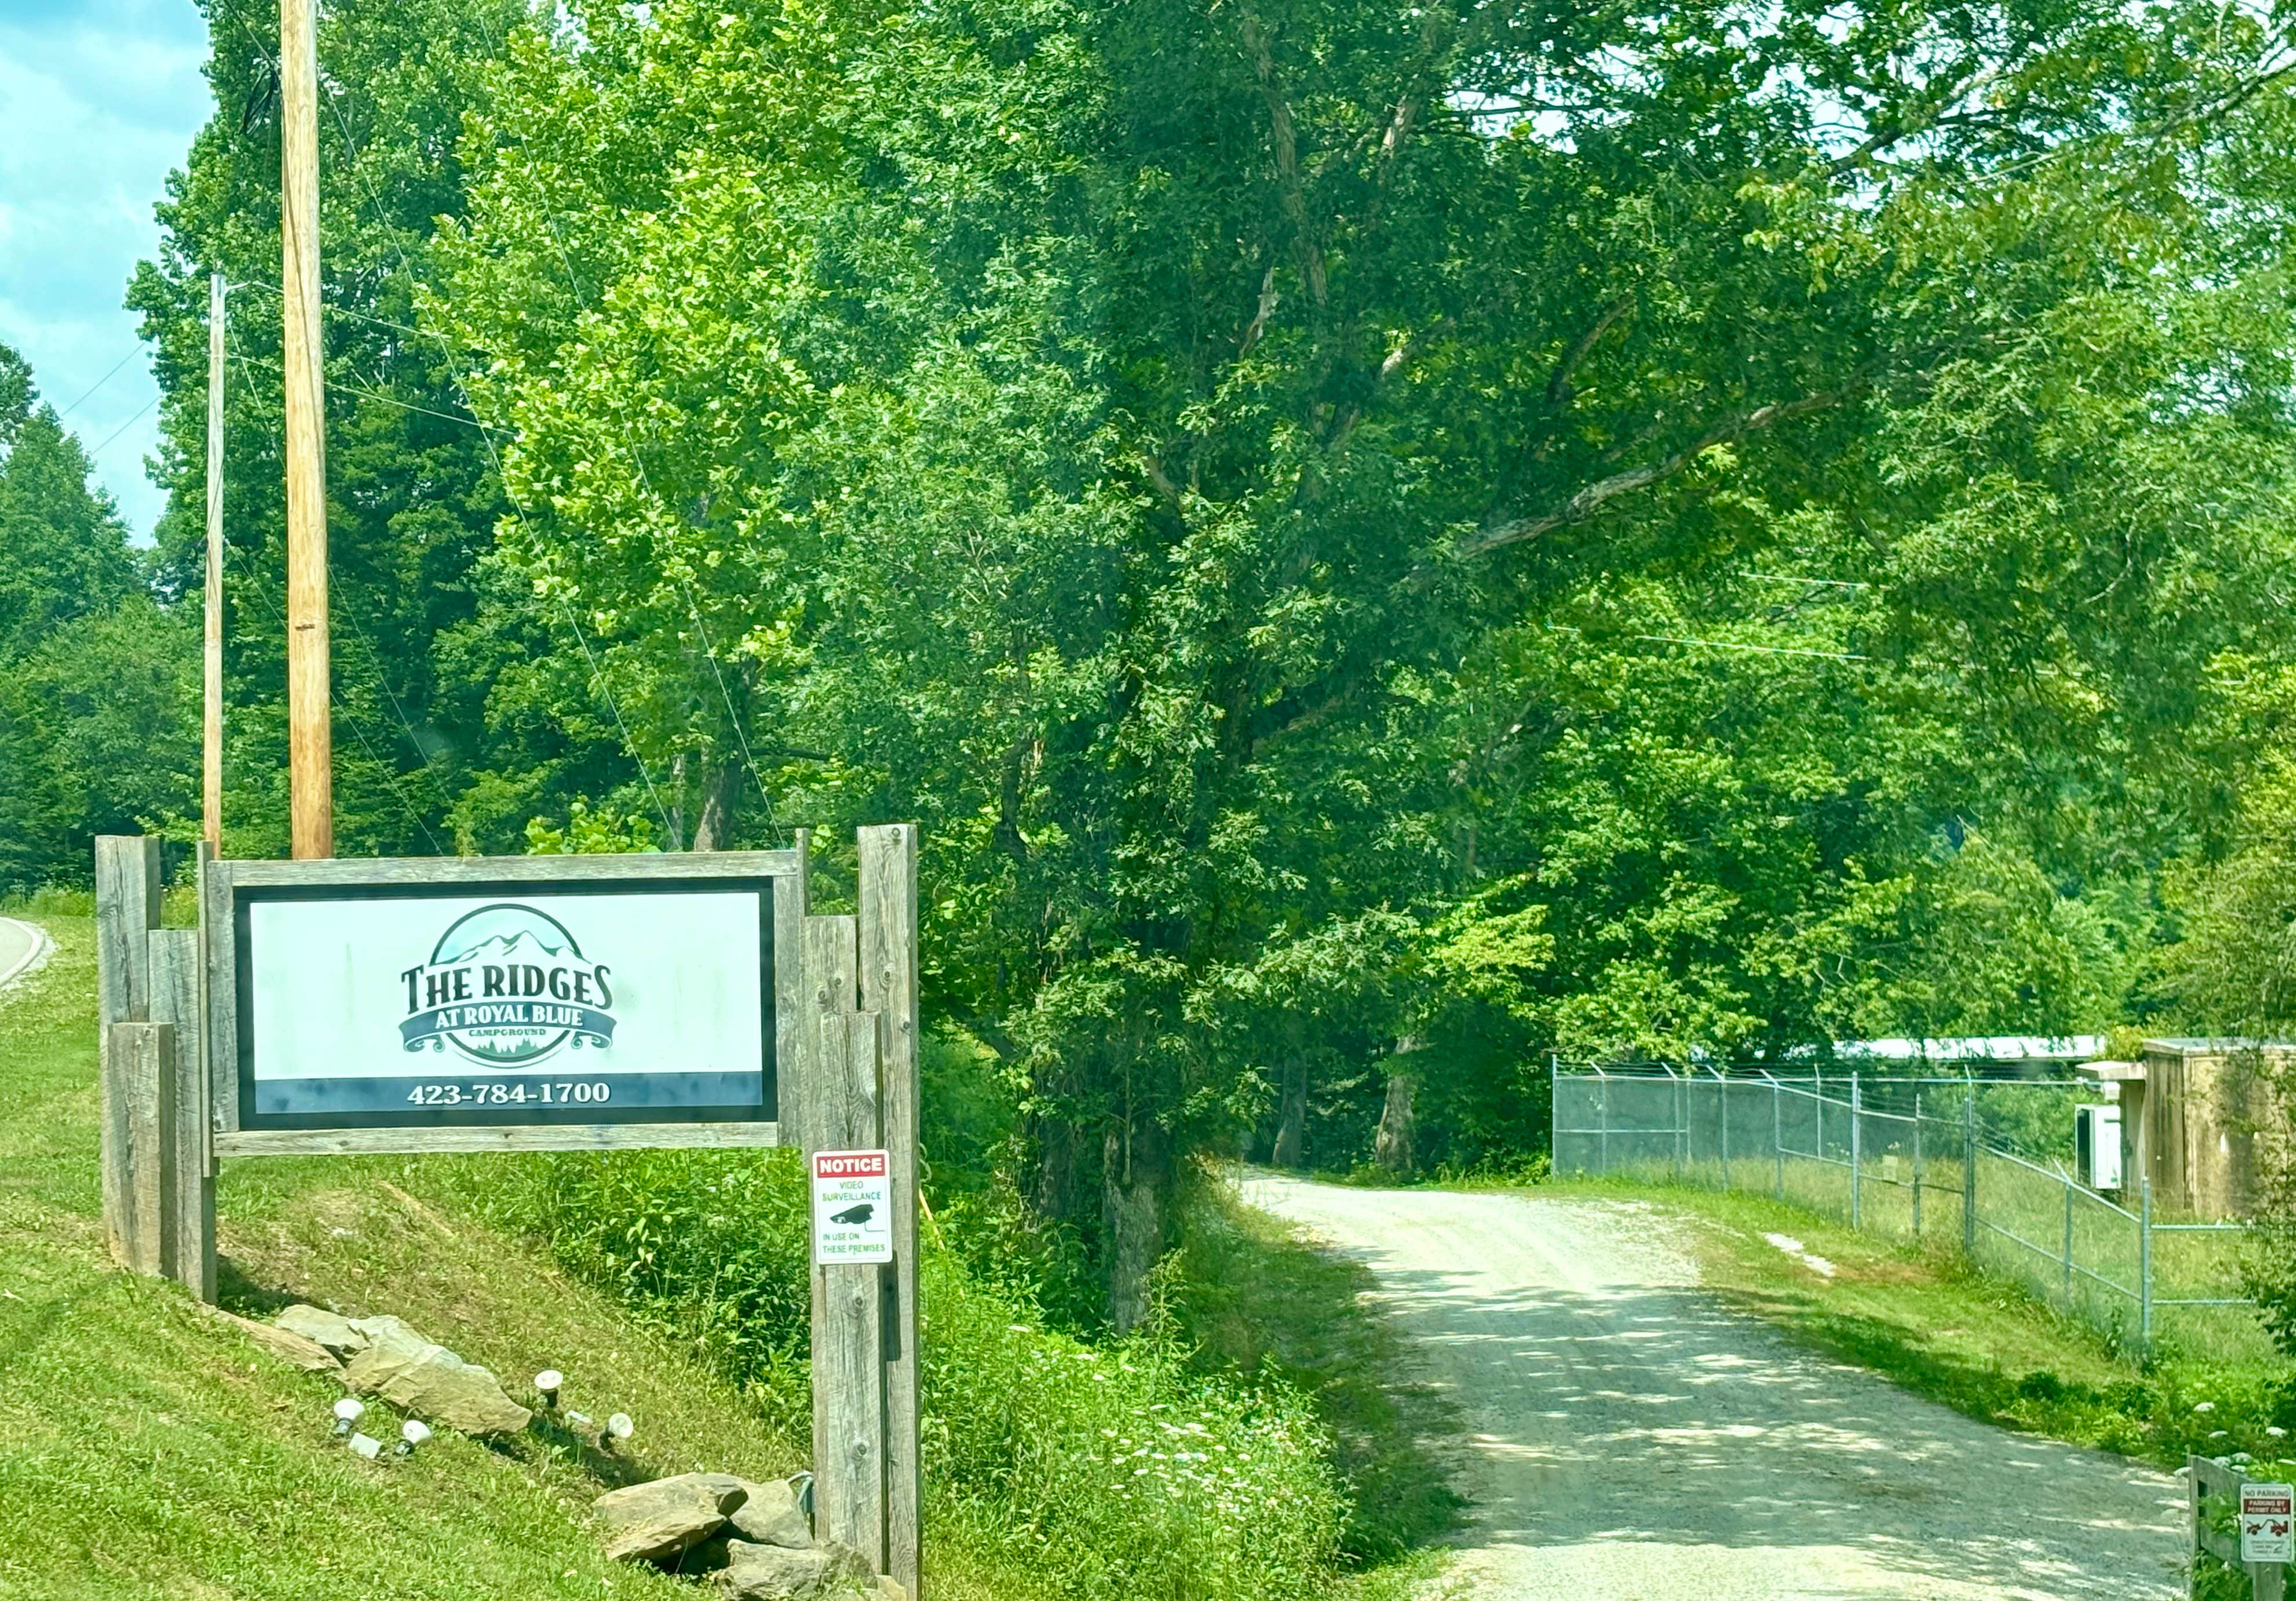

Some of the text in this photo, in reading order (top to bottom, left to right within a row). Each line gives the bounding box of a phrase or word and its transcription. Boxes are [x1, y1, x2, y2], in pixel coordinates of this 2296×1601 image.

[401, 964, 613, 1015] THE RIDGES
[435, 1004, 584, 1029] AT ROYAL BLUE
[468, 1029, 546, 1037] CAMPGROUND
[407, 1082, 611, 1105] 423-784-1700
[820, 1158, 882, 1173] NOTICE
[840, 1181, 863, 1189] VIDEO
[822, 1192, 881, 1201] SURVEILLANCE
[823, 1244, 885, 1253] THESE PREMISES
